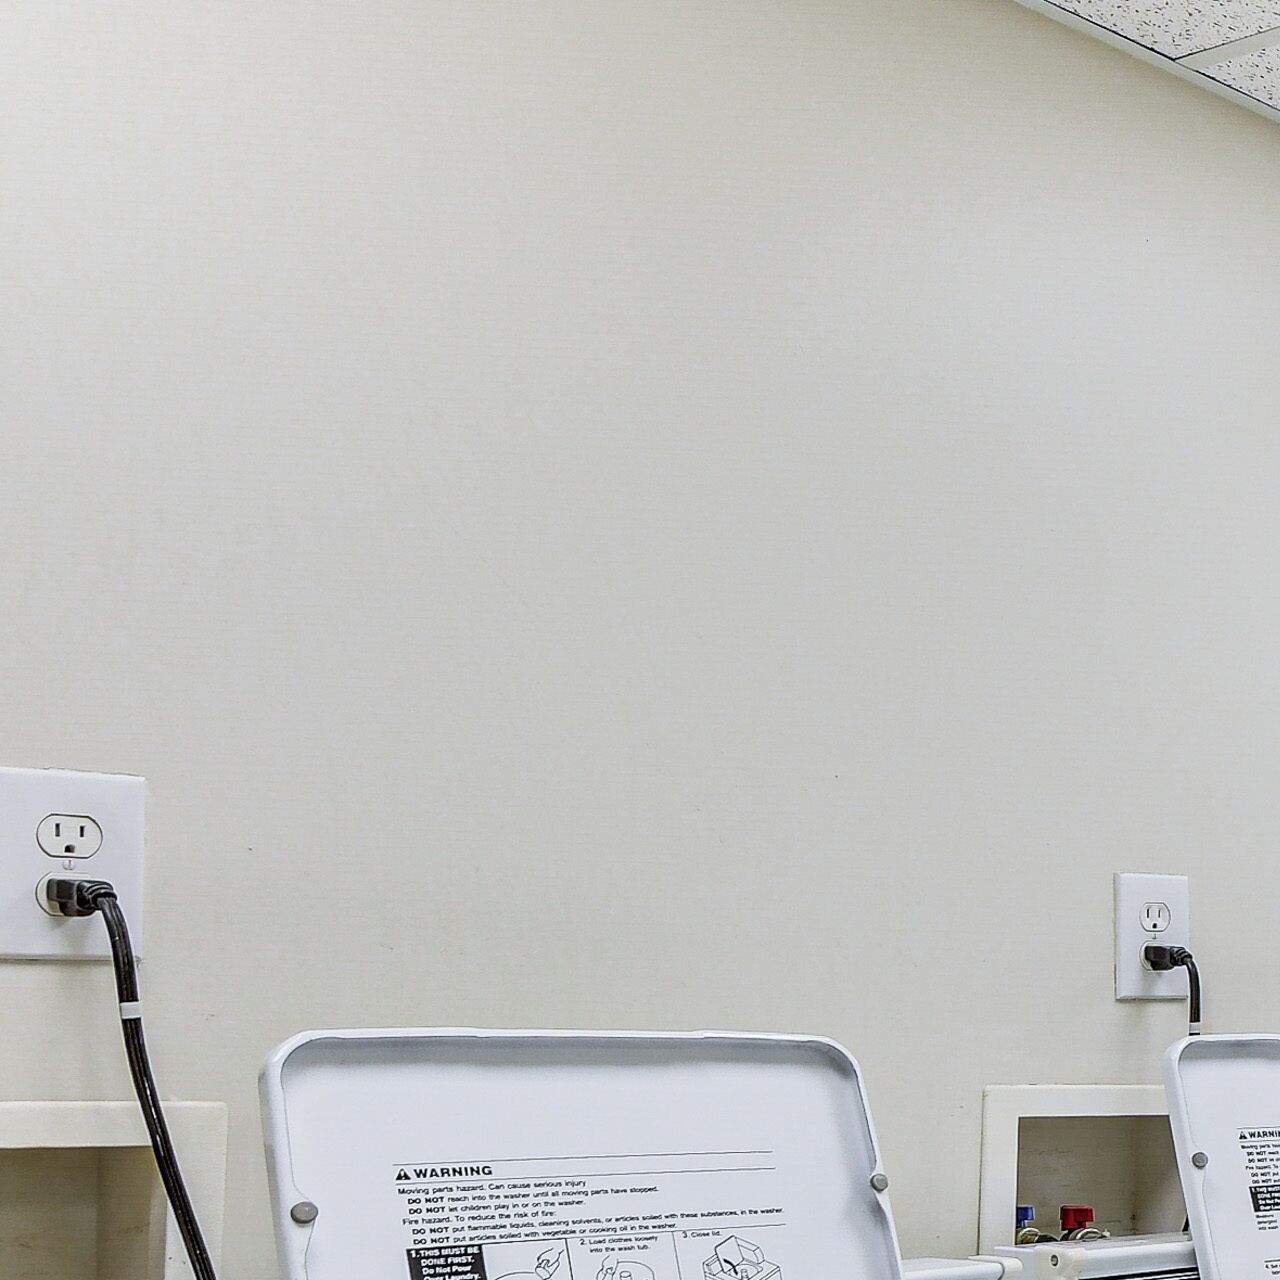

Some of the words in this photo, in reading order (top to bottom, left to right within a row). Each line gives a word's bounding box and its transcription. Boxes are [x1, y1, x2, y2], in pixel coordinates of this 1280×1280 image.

[414, 1166, 493, 1179] WARNING
[494, 1203, 509, 1211] play
[538, 1219, 569, 1227] cleaning
[635, 1235, 658, 1243] loosely
